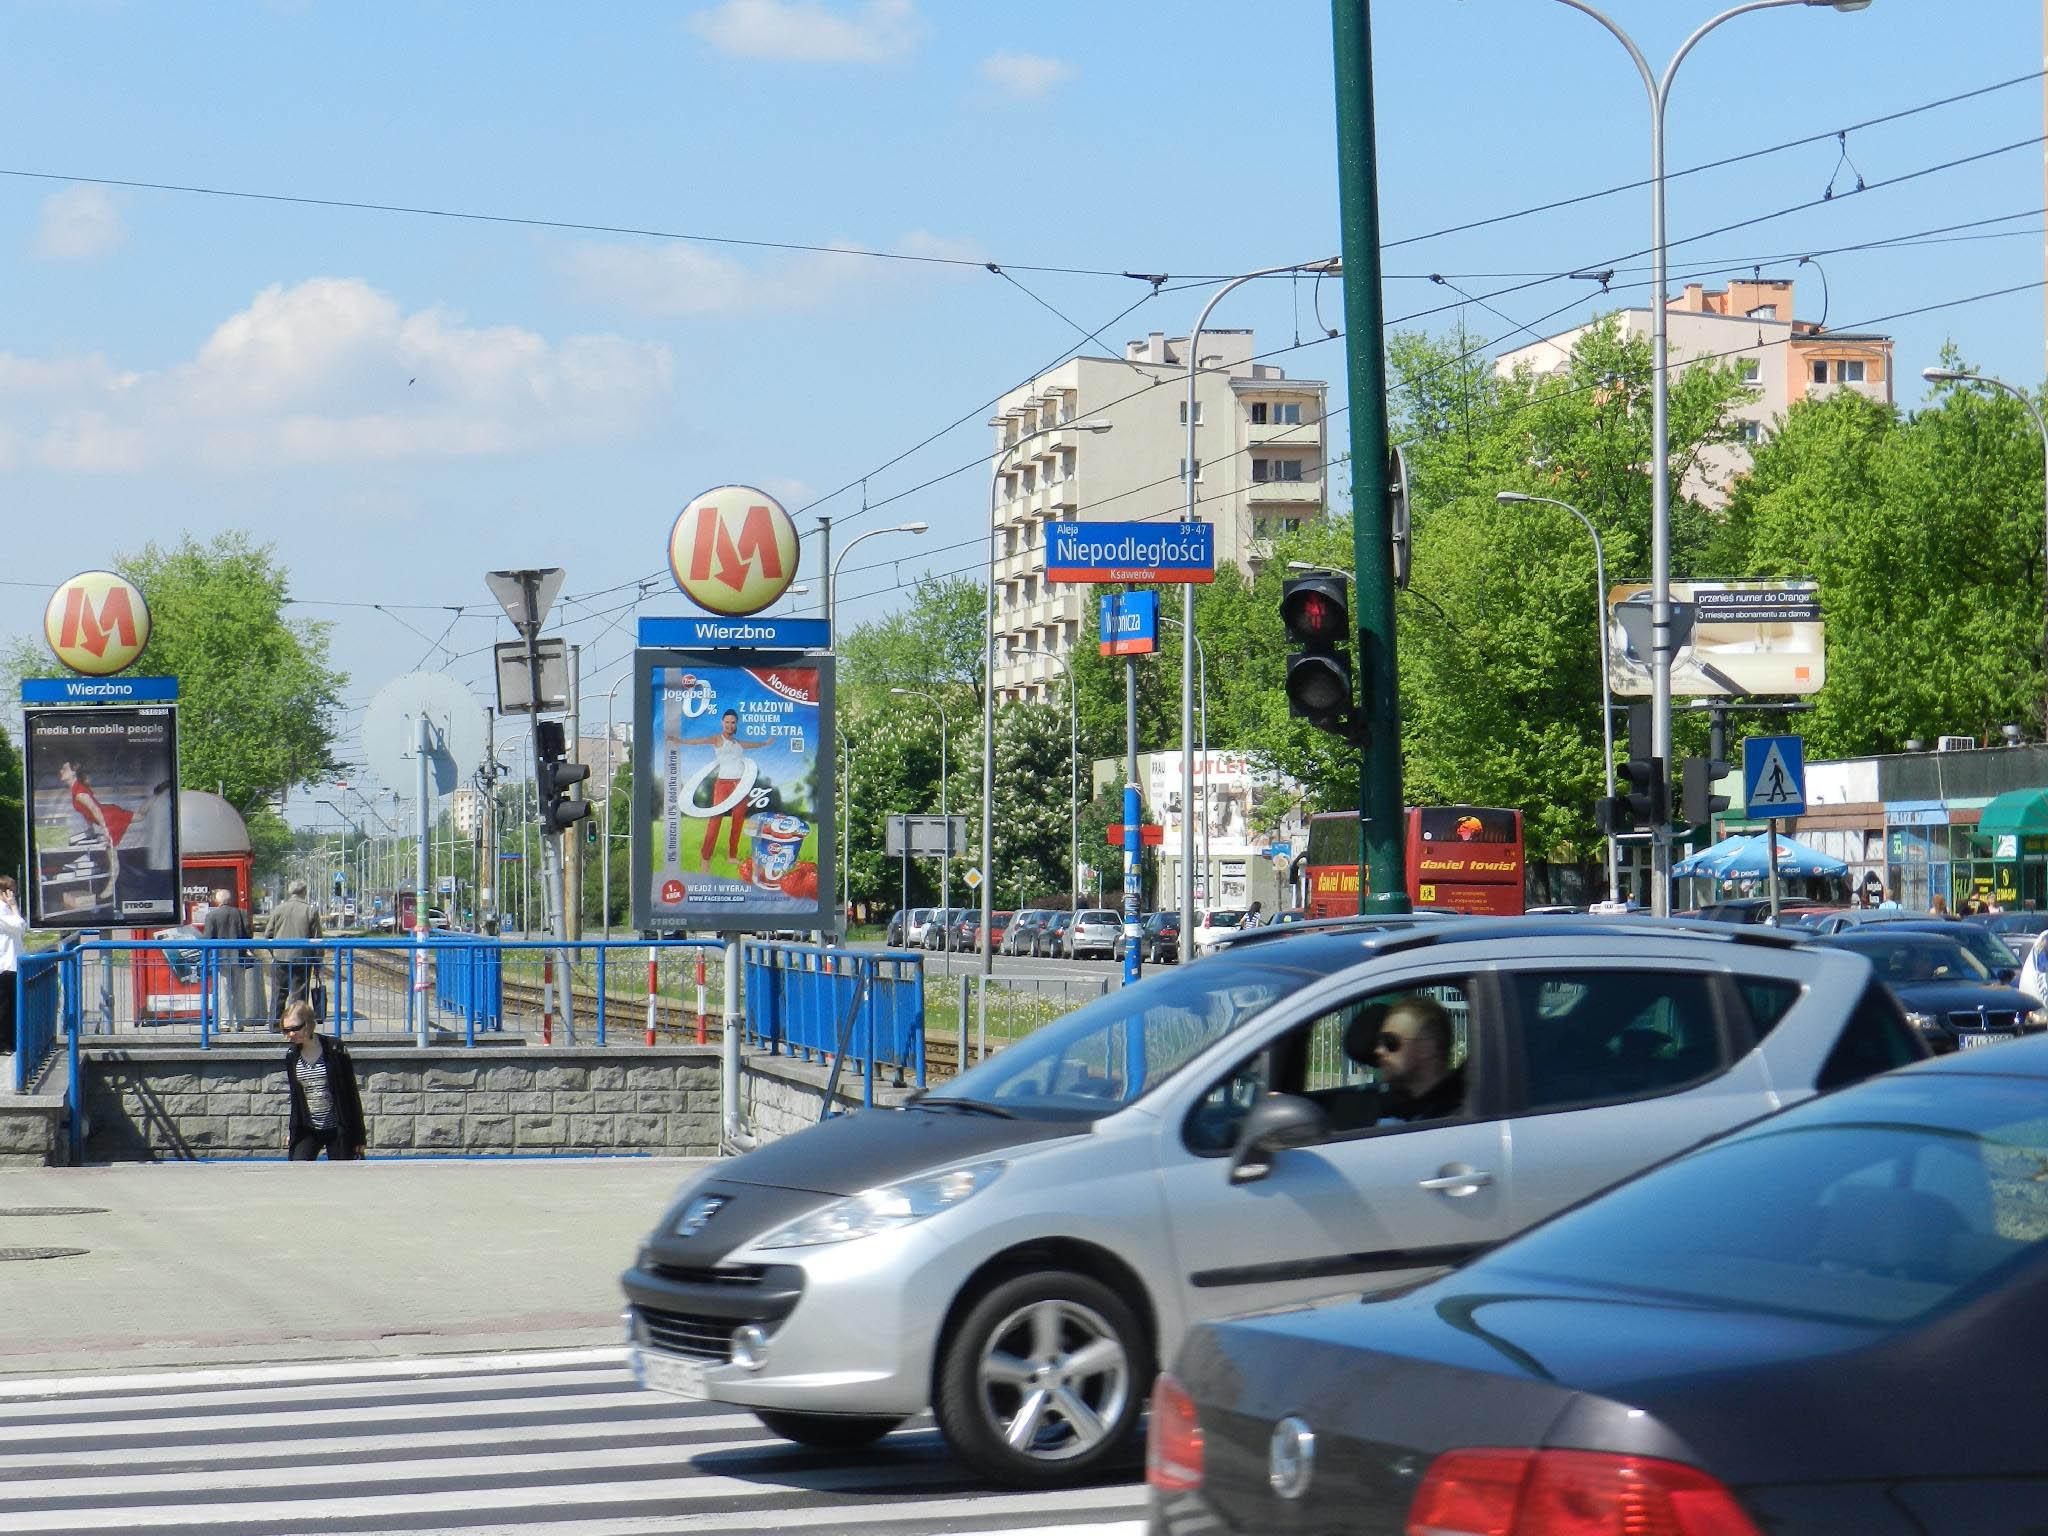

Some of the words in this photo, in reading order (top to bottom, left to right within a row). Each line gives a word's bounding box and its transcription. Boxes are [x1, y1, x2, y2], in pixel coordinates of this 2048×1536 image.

[1057, 524, 1079, 536] Aleja
[1180, 524, 1207, 535] 39-47
[1057, 537, 1205, 567] Niepodległości
[1110, 569, 1155, 579] Ksawerów
[1698, 594, 1734, 604] przenieś
[1764, 593, 1776, 602] do
[1778, 592, 1809, 602] Orange
[1699, 611, 1704, 619] 3
[1735, 610, 1777, 618] abonamentu
[1788, 610, 1811, 618] darmo
[696, 623, 776, 639] Wierzbno
[66, 683, 133, 695] Wierzbno
[739, 702, 745, 713] Z
[750, 700, 794, 713] KAŻDYM
[742, 714, 781, 723] KROKIEM
[36, 725, 69, 735] media
[71, 725, 87, 735] for
[89, 724, 125, 734] mobile
[127, 723, 164, 735] people
[746, 725, 767, 736] COŚ
[771, 726, 804, 736] EXTRA
[1420, 859, 1465, 870] daniel
[1469, 860, 1517, 871] tourist
[1317, 871, 1339, 891] daniel
[719, 884, 752, 893] WYGRAJ!
